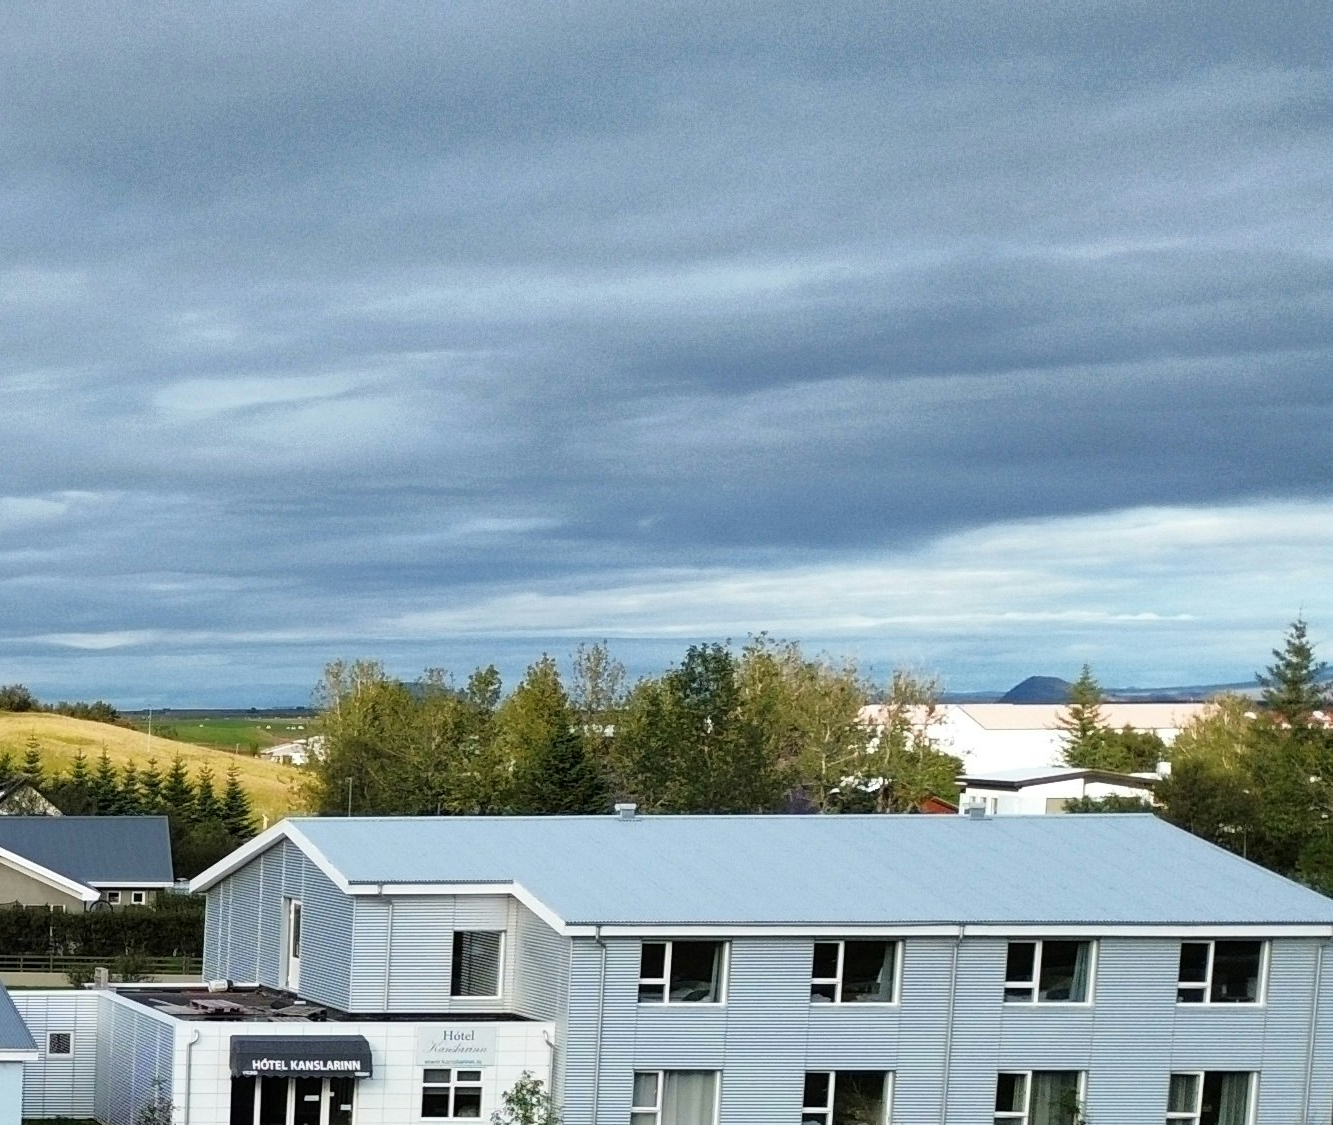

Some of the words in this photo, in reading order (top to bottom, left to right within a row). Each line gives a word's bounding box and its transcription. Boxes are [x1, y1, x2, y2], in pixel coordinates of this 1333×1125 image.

[443, 1030, 475, 1041] Hótel
[252, 1057, 288, 1071] HÓTEL
[290, 1059, 361, 1071] KANSLARINN
